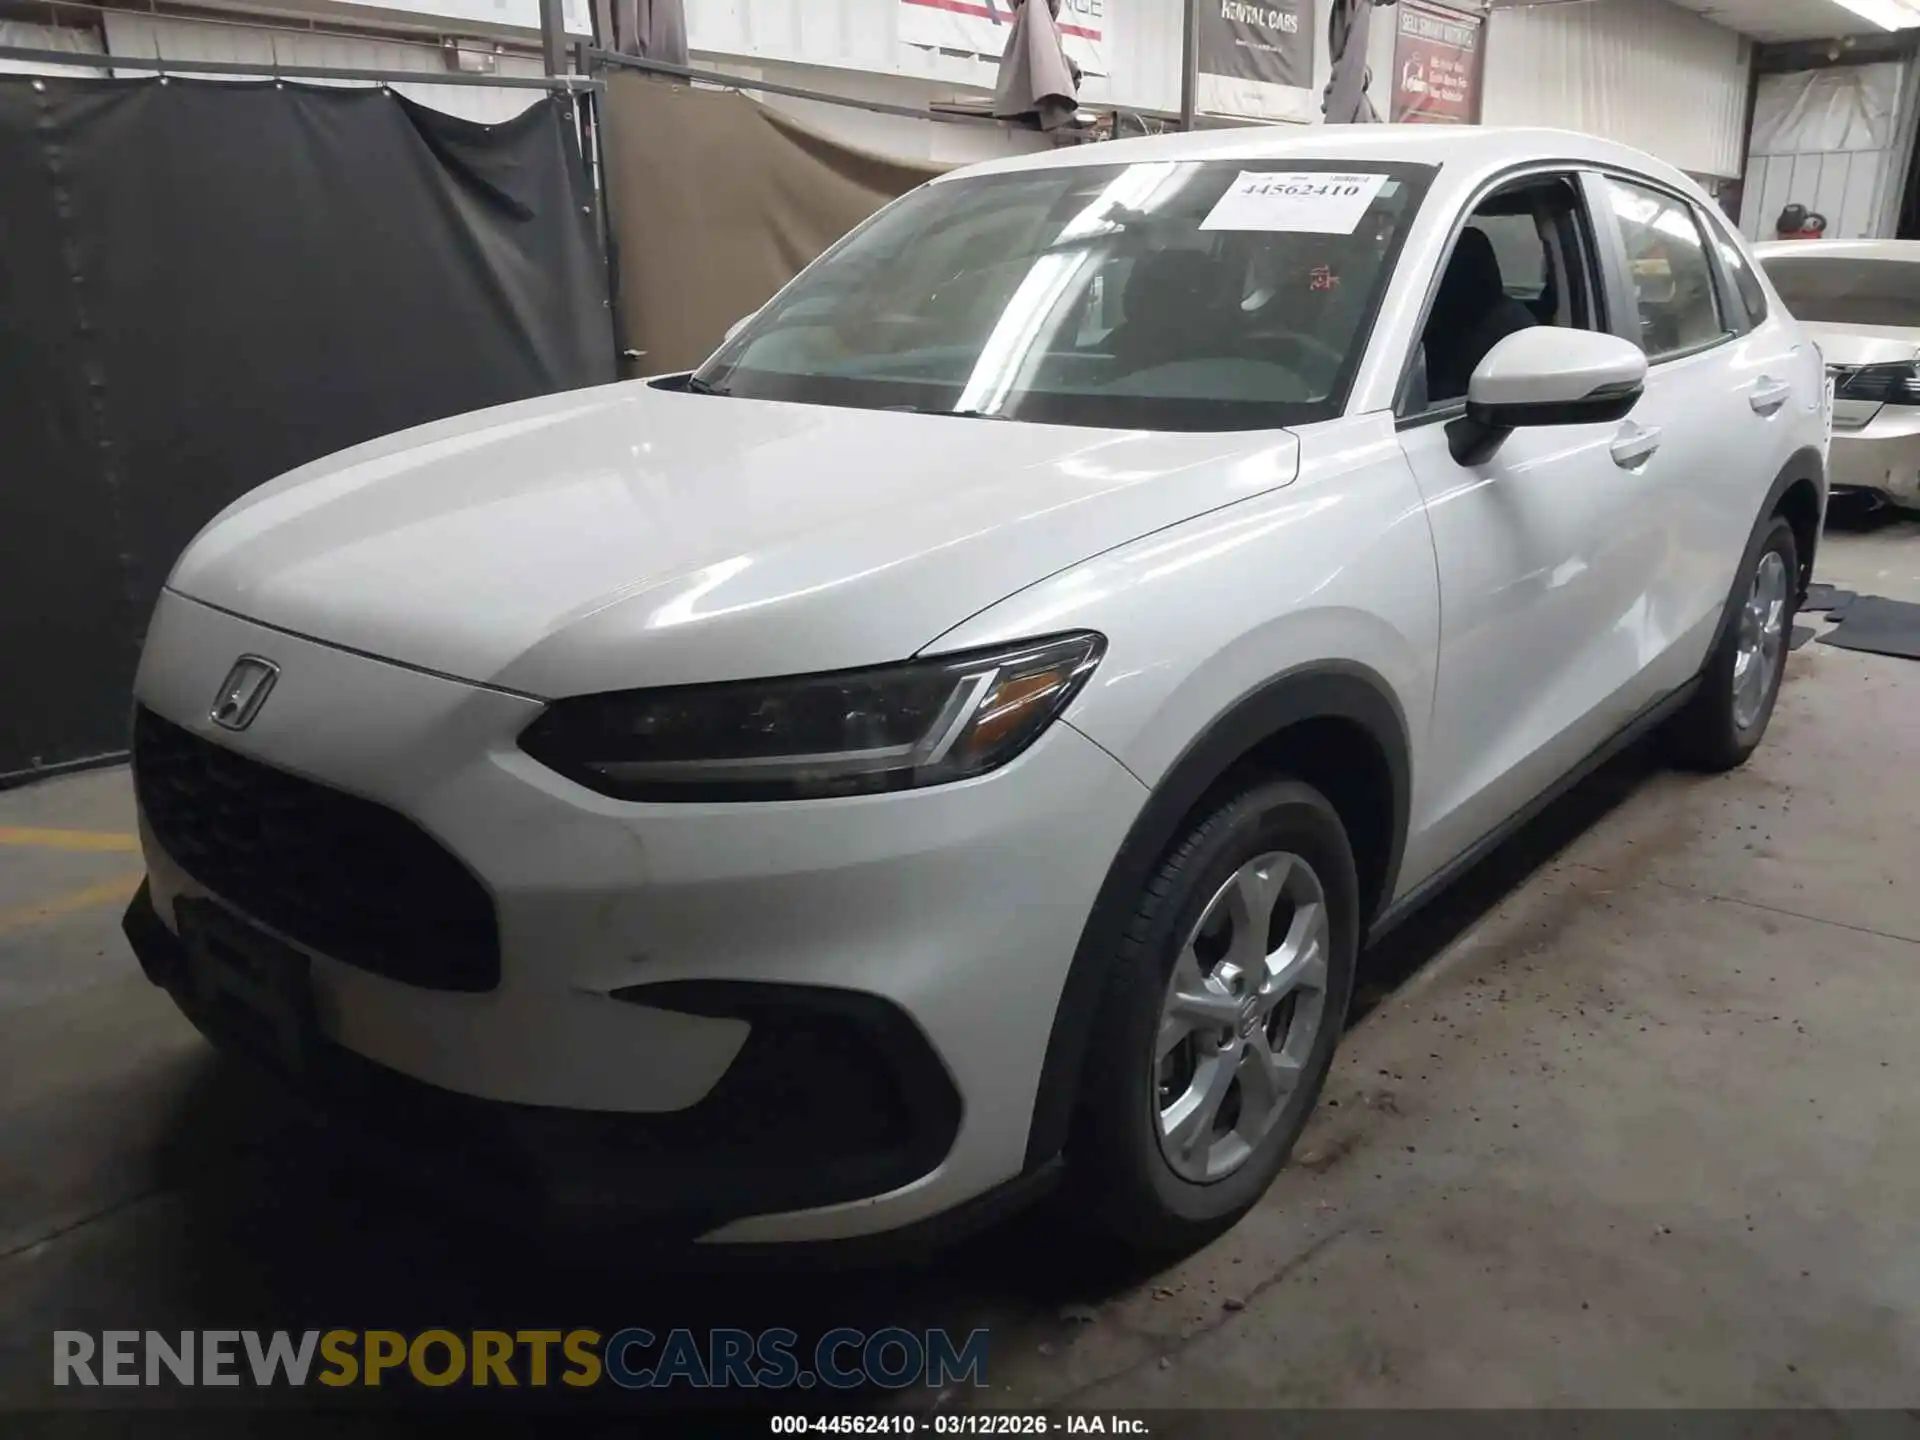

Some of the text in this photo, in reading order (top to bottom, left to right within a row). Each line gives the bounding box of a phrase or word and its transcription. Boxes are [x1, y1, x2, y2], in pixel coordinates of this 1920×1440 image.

[1222, 0, 1298, 33] RENTAL CARS
[1240, 183, 1361, 197] 44562410
